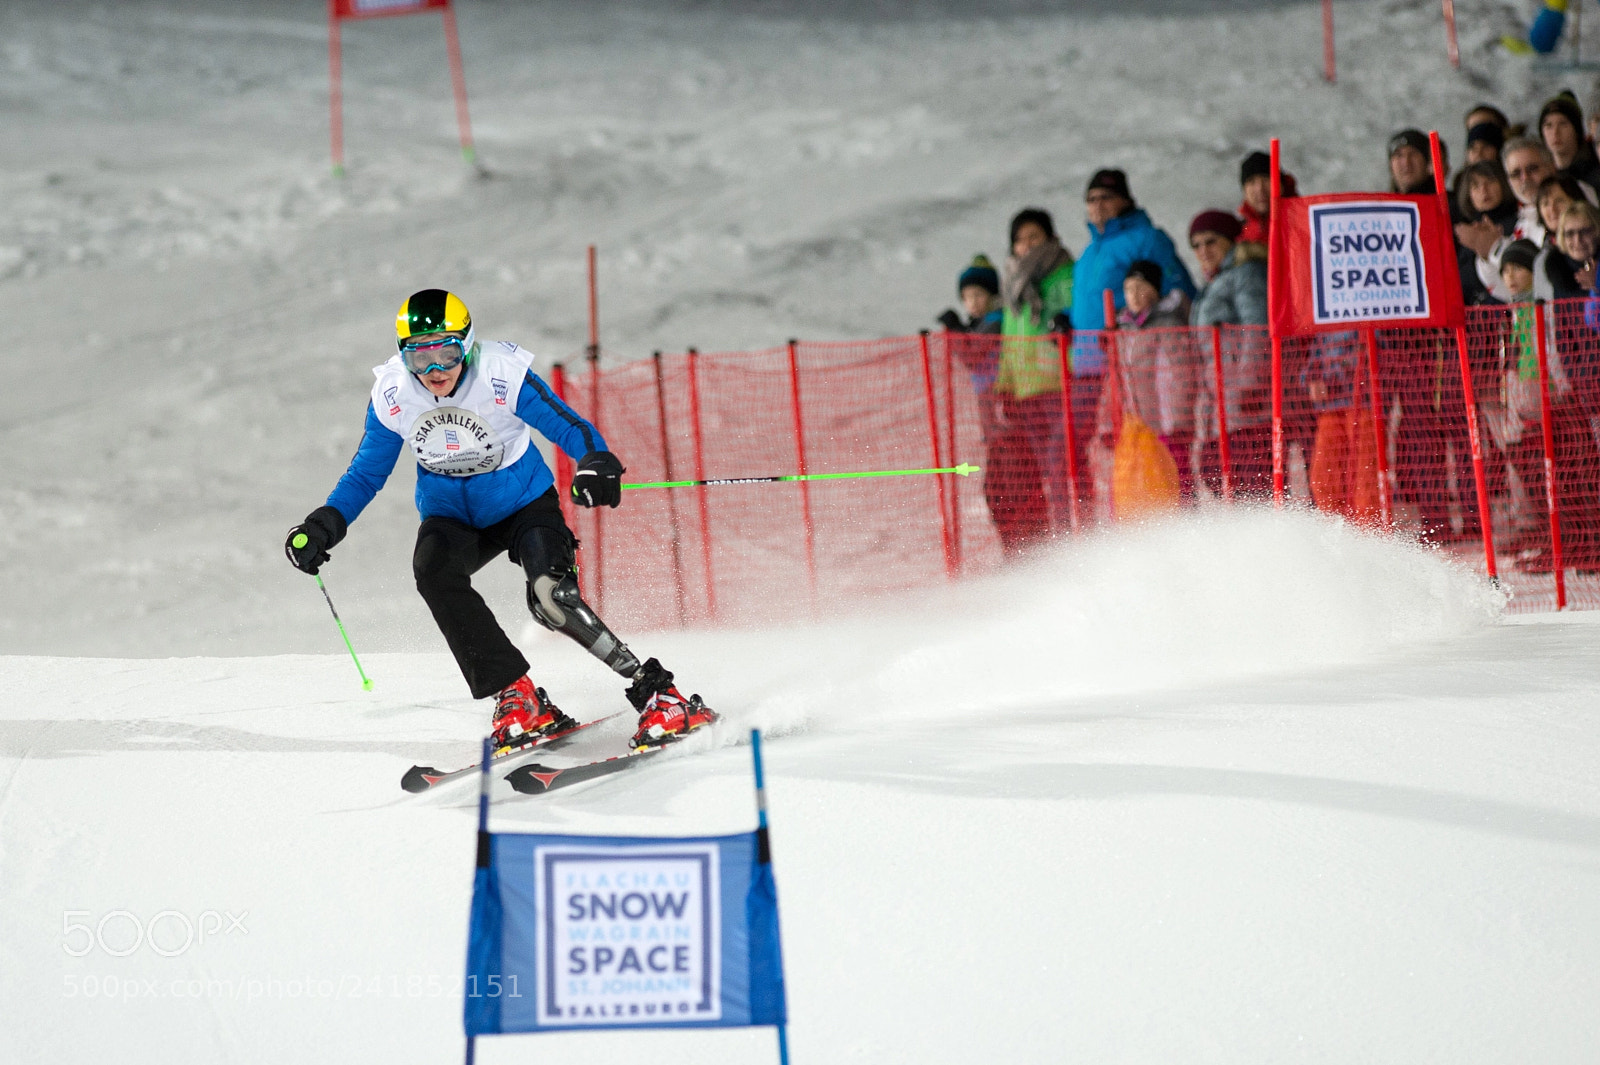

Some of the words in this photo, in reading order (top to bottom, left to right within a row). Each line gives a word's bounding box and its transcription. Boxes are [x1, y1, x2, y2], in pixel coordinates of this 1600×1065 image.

[1328, 219, 1406, 233] FLACHAU
[1329, 233, 1406, 254] SNOW
[1330, 254, 1408, 268] WAGRAIN
[1331, 267, 1410, 290] SPACE
[1331, 291, 1350, 304] ST.
[1353, 288, 1412, 302] JOHANN
[1333, 305, 1412, 319] SALZBURG
[415, 420, 435, 444] STAR
[433, 413, 489, 442] CHALLENGE
[566, 872, 690, 889] FLACHAU
[567, 891, 690, 921] SNOW
[567, 926, 691, 943] WAGRAIN
[568, 945, 690, 975] SPACE
[568, 980, 594, 997] ST.
[600, 978, 691, 996] JOHANN
[569, 1002, 691, 1018] SALZBURG
